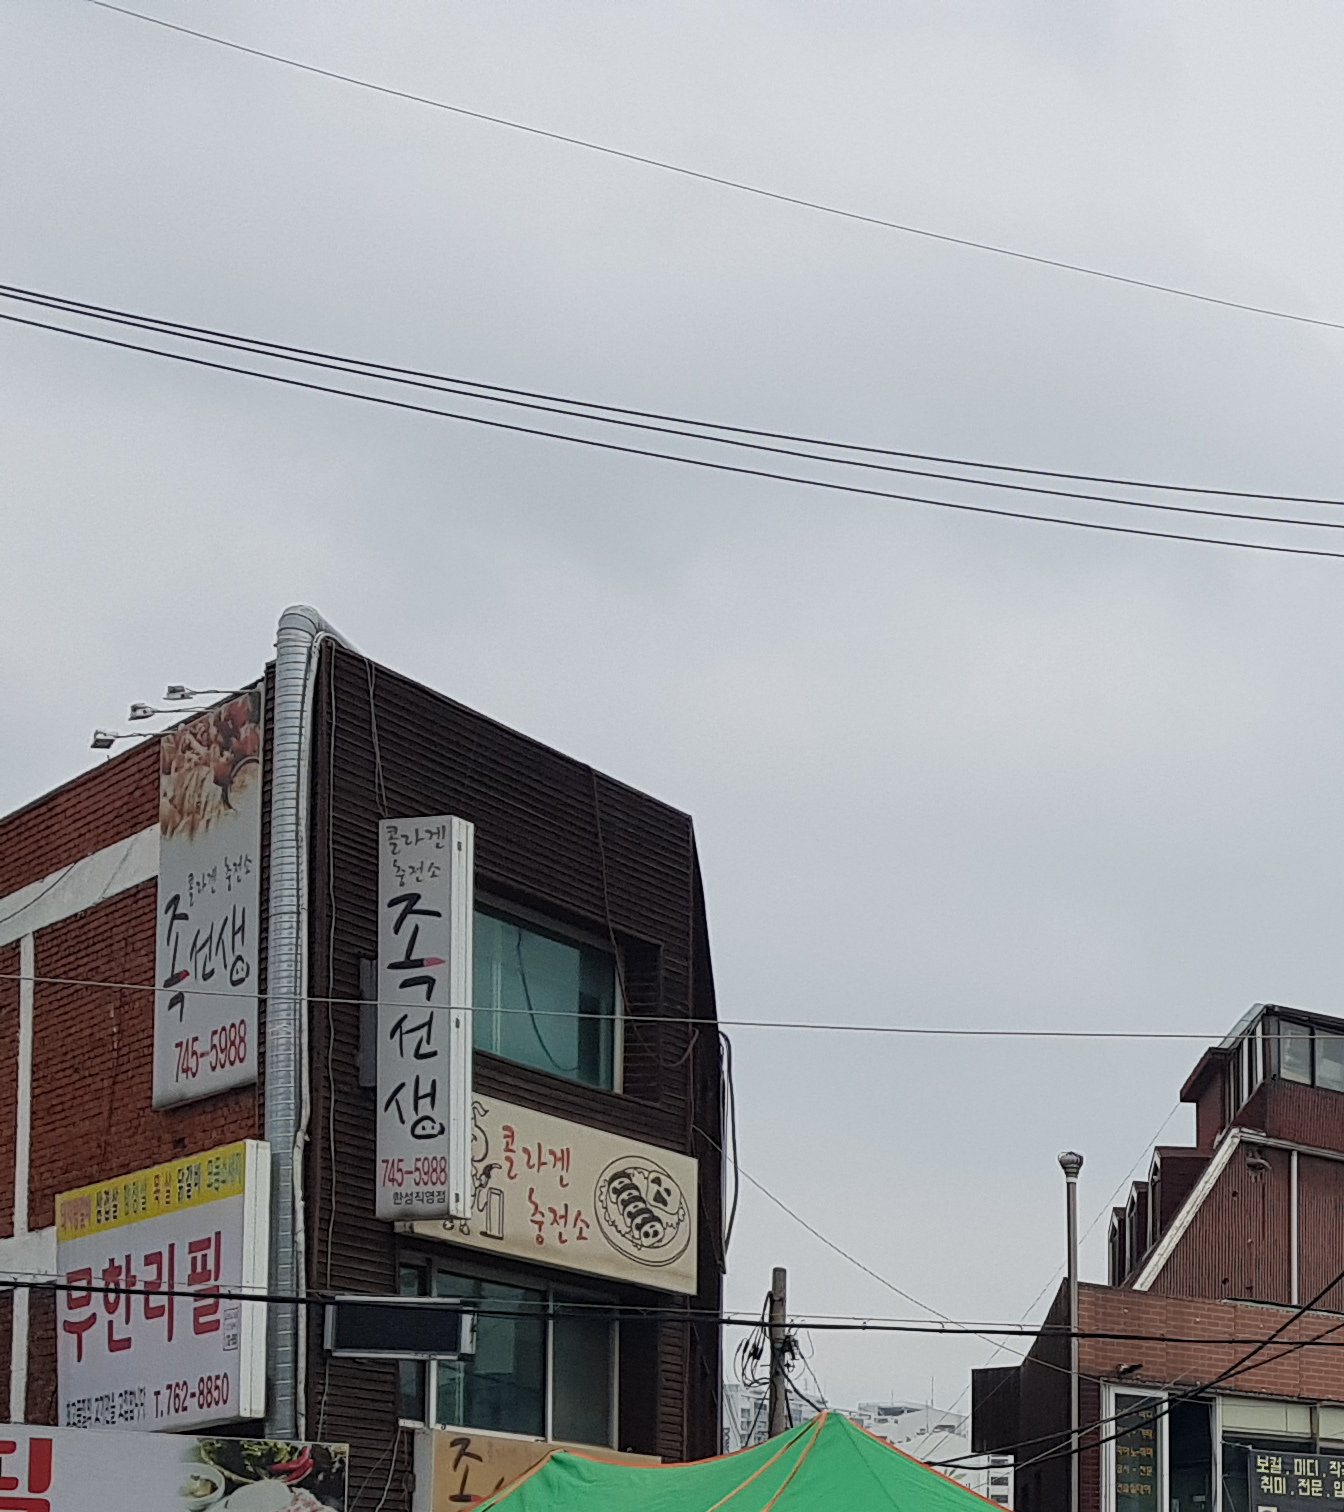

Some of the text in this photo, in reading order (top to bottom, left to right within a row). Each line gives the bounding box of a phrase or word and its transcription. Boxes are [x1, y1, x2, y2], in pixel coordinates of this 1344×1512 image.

[386, 825, 446, 855] 콜라겐
[392, 859, 441, 887] 충전소
[174, 1018, 247, 1083] 745-5988
[381, 1156, 448, 1187] 745-5988
[501, 1124, 571, 1188] 콜라겐
[527, 1187, 590, 1246] 충전소
[63, 1231, 222, 1363] 무한리필
[153, 1372, 230, 1419] T.762-8850
[1256, 1455, 1282, 1475] 보컬
[1294, 1459, 1319, 1477] 미디
[1260, 1476, 1287, 1495] 취미
[1298, 1479, 1323, 1497] 전문
